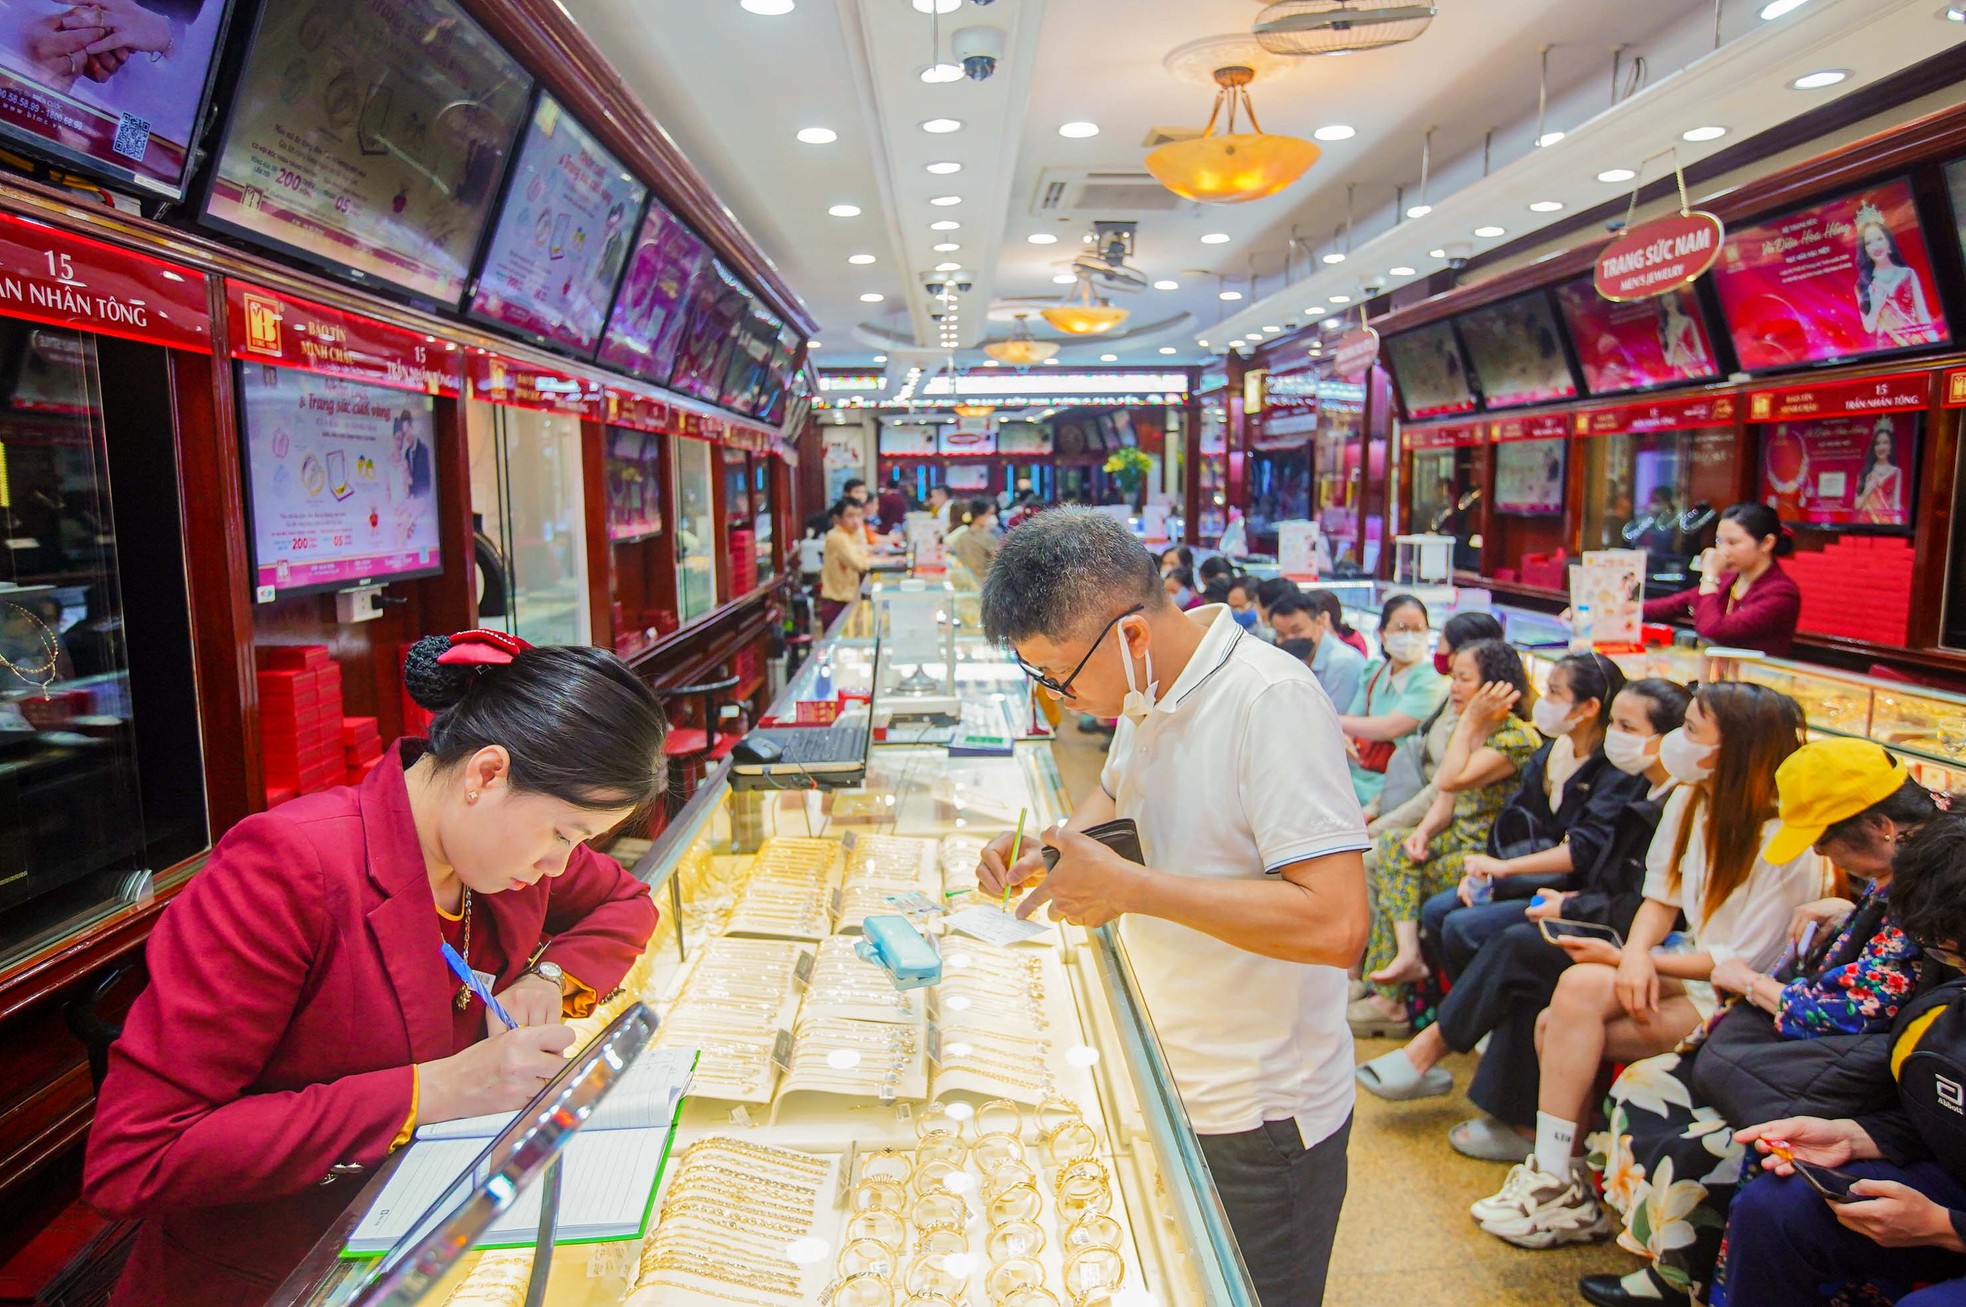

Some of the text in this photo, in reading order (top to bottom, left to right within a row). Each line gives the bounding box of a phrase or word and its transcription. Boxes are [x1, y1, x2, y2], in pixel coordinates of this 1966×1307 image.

[275, 167, 302, 191] 200
[335, 195, 350, 213] 05
[1602, 227, 1711, 279] TRANG SỨC NAM
[44, 250, 74, 280] 15
[1646, 263, 1684, 286] JEWELRY
[29, 283, 92, 316] NHÂN
[96, 295, 147, 327] TÔNG
[328, 324, 347, 341] TÍN
[301, 340, 328, 360] MINH
[414, 346, 426, 363] 15
[308, 392, 334, 415] Trang
[1894, 394, 1918, 406] TÔNG
[292, 537, 308, 550] 200
[1937, 1097, 1963, 1116] Abbott
